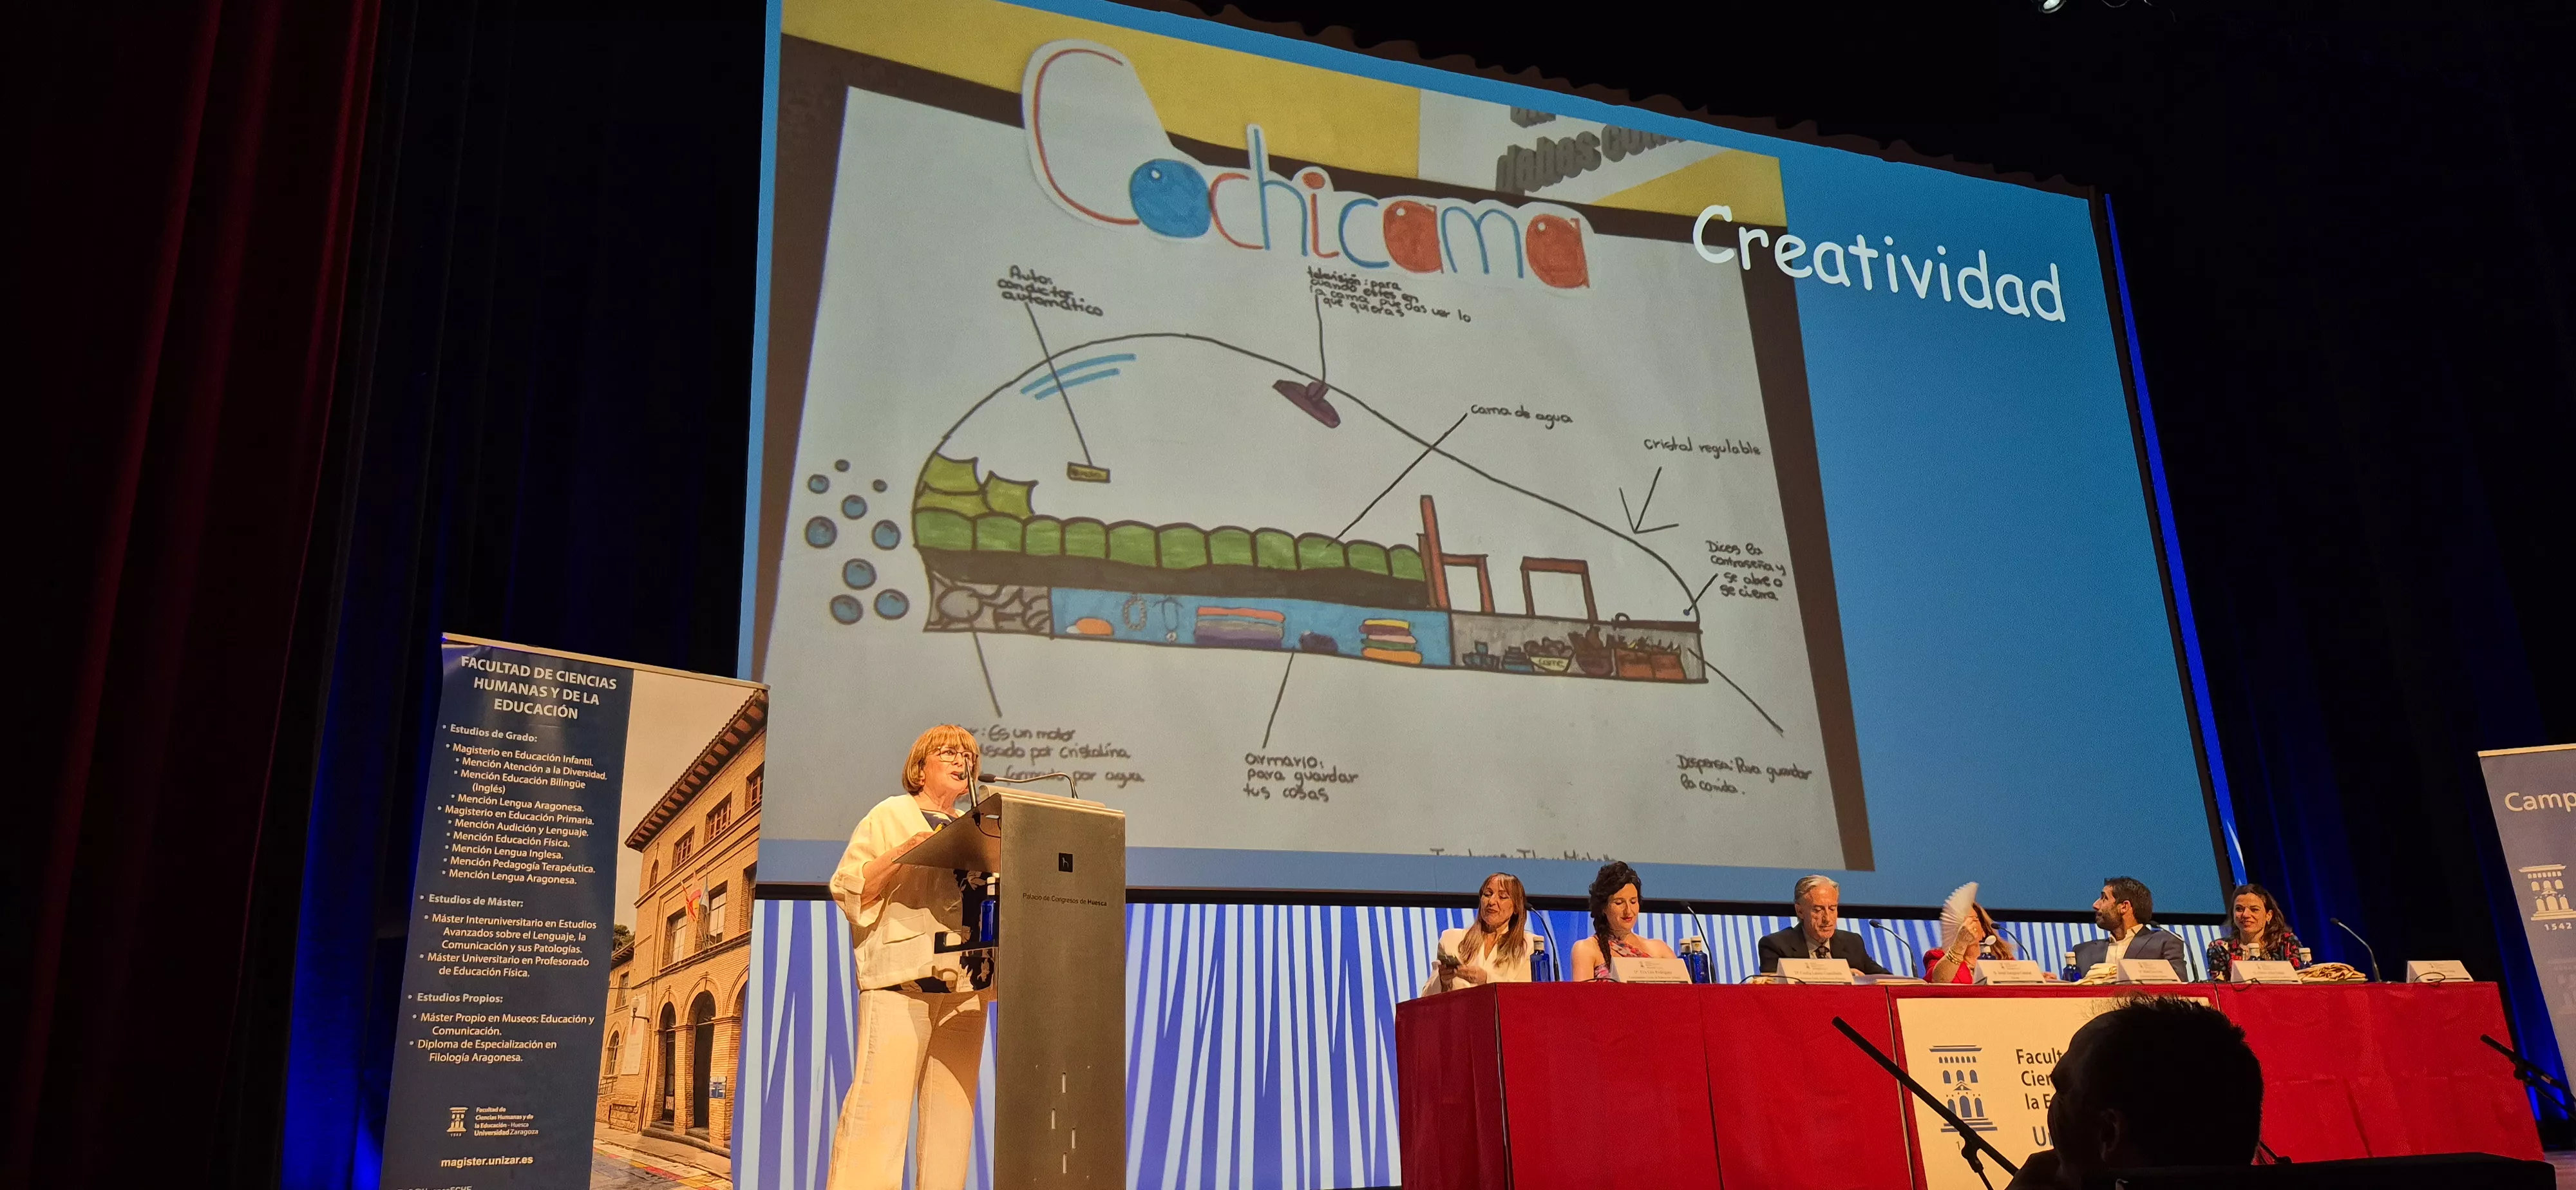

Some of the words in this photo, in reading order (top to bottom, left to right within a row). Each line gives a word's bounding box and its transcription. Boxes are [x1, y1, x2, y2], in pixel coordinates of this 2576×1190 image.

[1035, 48, 1589, 290] Cochicama
[1692, 204, 2067, 323] Creatividad
[1370, 280, 1401, 291] para
[1310, 285, 1327, 296] la
[1331, 290, 1370, 305] cama
[1432, 308, 1450, 317] ver
[1458, 309, 1472, 323] lo
[1323, 298, 1343, 308] que
[1401, 293, 1419, 303] en
[1471, 404, 1511, 416] cama
[1515, 404, 1531, 419] de
[1535, 413, 1573, 430] agua
[1643, 436, 1692, 451] cristal
[1699, 439, 1761, 459] regulable
[1705, 540, 1741, 555] Dices
[1745, 542, 1764, 555] la
[1776, 564, 1786, 576] y
[1723, 572, 1738, 583] se
[1743, 572, 1771, 587] abre
[1773, 578, 1783, 587] o
[1719, 584, 1736, 597] se
[1739, 585, 1779, 601] cierra
[461, 656, 531, 677] FACULTAD
[533, 667, 553, 680] DE
[556, 670, 617, 690] CIENCIAS
[473, 676, 547, 697] HUMANAS
[551, 687, 560, 699] Y
[562, 688, 581, 702] DE
[583, 692, 600, 706] LA
[494, 698, 578, 719] EDUCACIÓN
[450, 723, 489, 737] Estudios
[491, 729, 504, 739] de
[506, 731, 538, 742] Grado:
[989, 724, 1010, 741] Es
[1013, 728, 1032, 739] un
[1037, 728, 1076, 742] motor
[453, 742, 500, 757] Magisterio
[515, 750, 561, 762] Educación
[563, 755, 594, 766] Infantil.
[1030, 745, 1053, 766] por
[462, 757, 502, 769] Mención
[503, 760, 544, 773] Atención
[553, 765, 561, 775] la
[563, 766, 607, 780] Diversidad.
[1247, 768, 1285, 781] para
[1294, 765, 1359, 788] guardar
[460, 769, 500, 781] Mención
[502, 773, 548, 785] Educación
[550, 777, 586, 789] Bilingüe
[1073, 770, 1096, 786] por
[1105, 770, 1145, 789] agua
[1680, 773, 1697, 790] la
[472, 782, 506, 795] (Inglés)
[1243, 782, 1271, 800] tus
[1283, 786, 1329, 802] cosas
[457, 793, 498, 806] Mención
[499, 797, 533, 809] Lengua
[534, 800, 584, 813] Aragonesa.
[2505, 791, 2576, 812] Camp
[445, 804, 493, 817] Magisterio
[508, 810, 554, 822] Educación
[556, 814, 594, 826] Primaria.
[455, 818, 495, 830] Mención
[497, 822, 536, 833] Audición
[538, 827, 544, 836] y
[545, 826, 589, 838] Lenguaje.
[453, 831, 493, 842] Mención
[495, 834, 542, 846] Educación
[544, 838, 571, 847] Física.
[451, 843, 492, 855] Mención
[494, 846, 527, 858] Lengua
[529, 849, 564, 860] Inglesa.
[450, 856, 491, 867] Mención
[493, 858, 540, 872] Pedagogía
[542, 862, 596, 874] Terapéutica.
[449, 869, 489, 880] Mención
[491, 871, 525, 883] Lengua
[526, 874, 577, 885] Aragonesa.
[429, 893, 471, 905] Estudios
[473, 896, 486, 905] de
[487, 897, 524, 907] Máster:
[1023, 892, 1042, 901] Palacio
[1051, 895, 1078, 905] Congresos
[431, 913, 465, 923] Máster
[466, 915, 544, 927] Interuniversitario
[558, 919, 597, 929] Estudios
[2544, 922, 2573, 931] 1542
[442, 927, 494, 938] Avanzados
[495, 929, 521, 939] sobre
[522, 930, 531, 940] el
[533, 930, 576, 943] Lenguaje,
[578, 932, 586, 941] la
[442, 940, 508, 951] Comunicación
[509, 944, 516, 954] y
[534, 943, 582, 955] Patologías.
[427, 952, 460, 962] Máster
[462, 953, 520, 965] Universitario
[535, 956, 589, 966] Profesorado
[439, 965, 451, 975] de
[453, 966, 501, 977] Educación
[503, 968, 530, 978] Física.
[417, 992, 460, 1003] Estudios
[462, 993, 504, 1005] Propios:
[421, 1012, 454, 1022] Máster
[455, 1012, 486, 1025] Propio
[502, 1014, 539, 1023] Museos:
[540, 1014, 587, 1023] Educación
[588, 1017, 595, 1025] y
[432, 1026, 502, 1035] Comunicación.
[417, 1039, 459, 1051] Diploma
[460, 1039, 473, 1048] de
[475, 1039, 544, 1051] Especialización
[429, 1052, 469, 1064] Filología
[471, 1052, 523, 1064] Aragonesa.
[2016, 1048, 2063, 1064] Facult
[2025, 1093, 2040, 1110] la
[441, 1156, 533, 1169] magister.unizar.es
